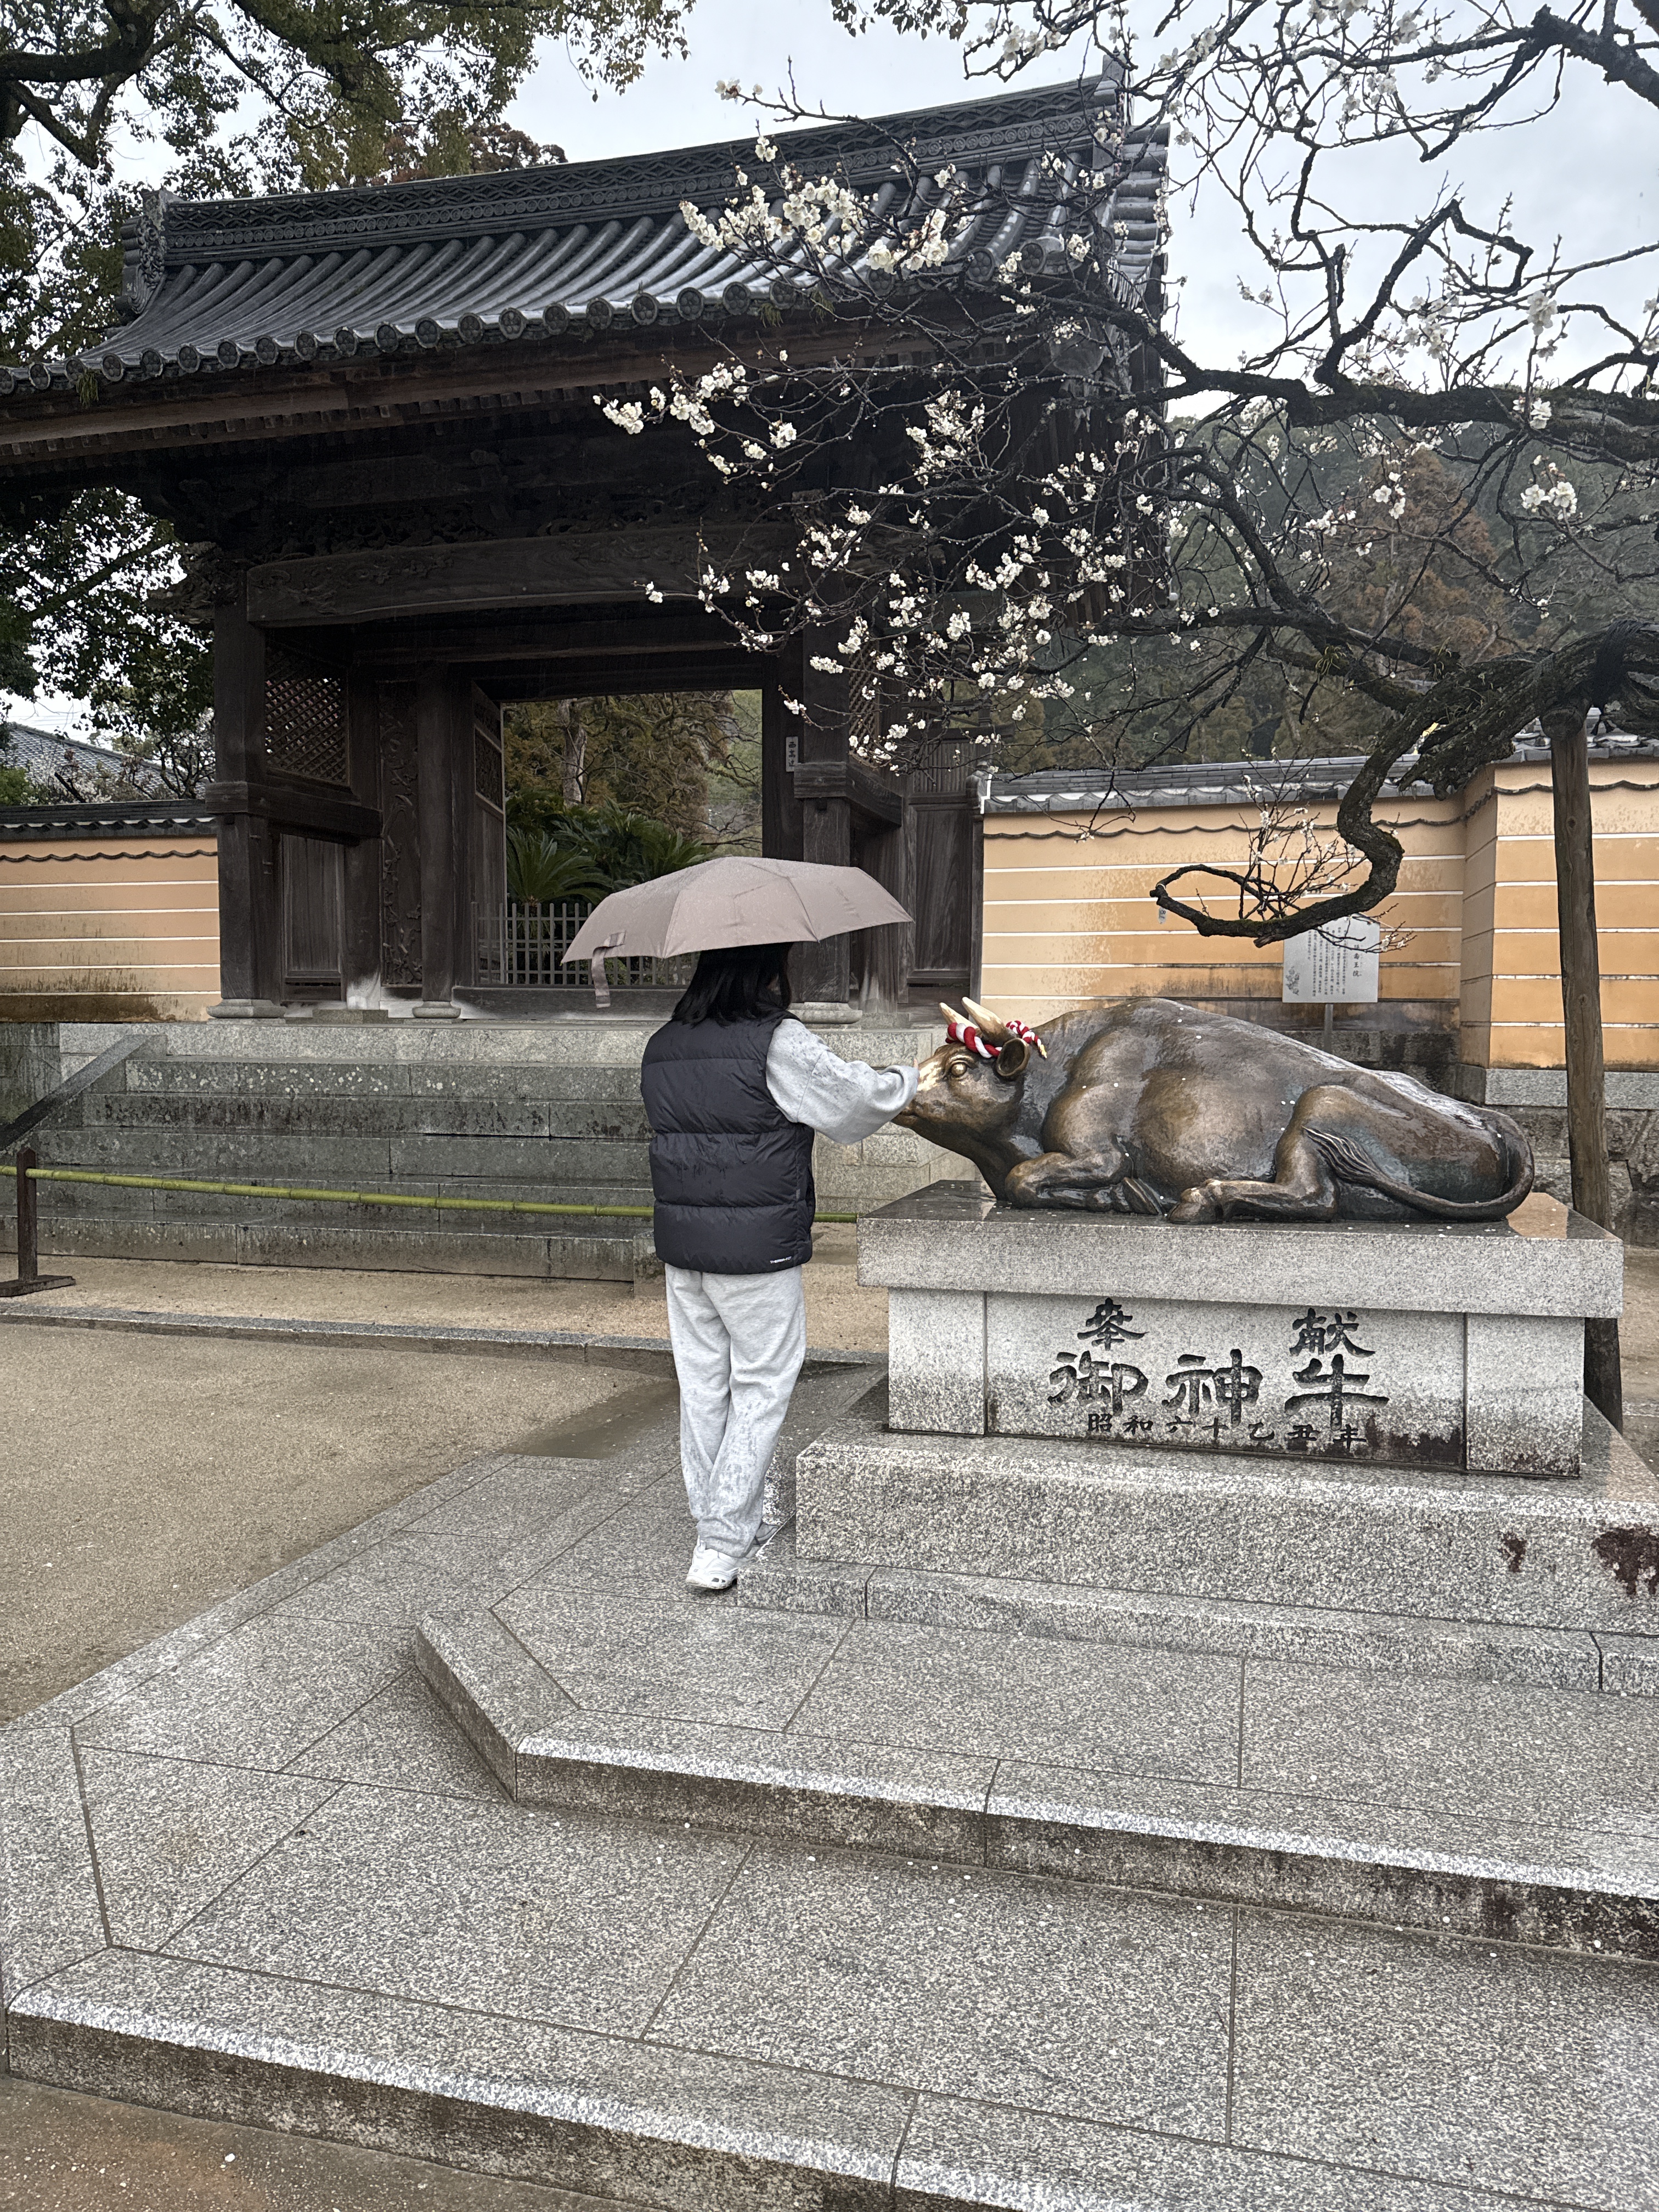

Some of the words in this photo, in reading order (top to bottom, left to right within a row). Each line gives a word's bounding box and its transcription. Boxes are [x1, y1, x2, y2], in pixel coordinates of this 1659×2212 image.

[1047, 1348, 1390, 1431] 御神牛
[1088, 1414, 1367, 1451] 昭和六十乙丑年
